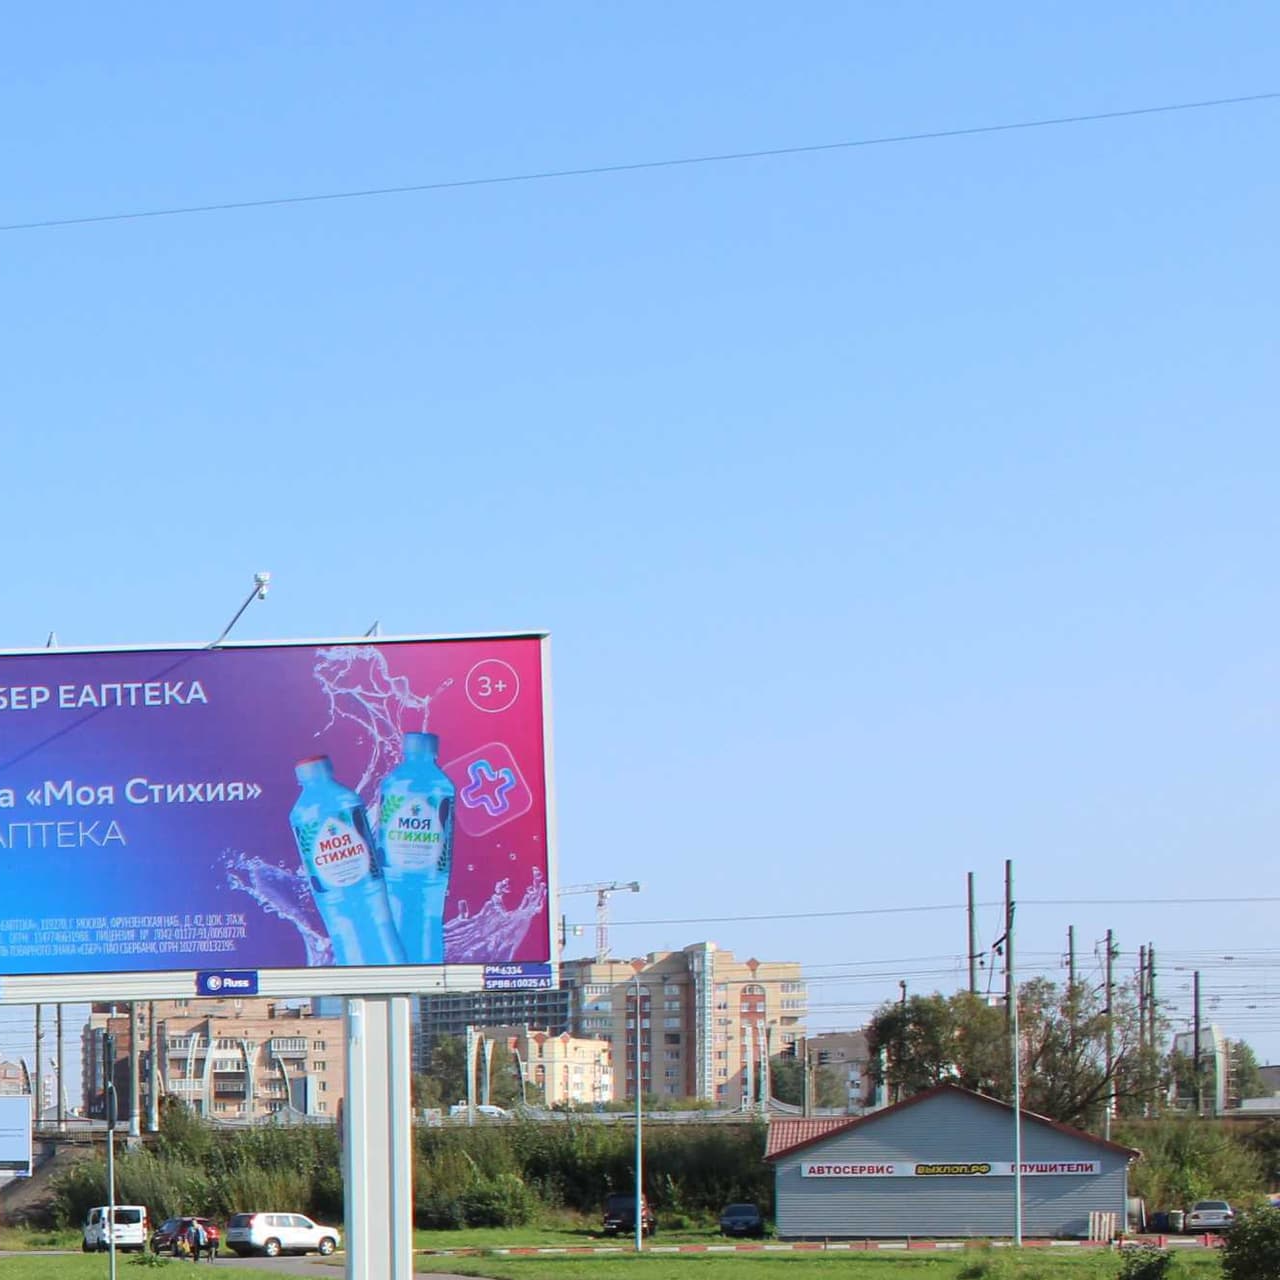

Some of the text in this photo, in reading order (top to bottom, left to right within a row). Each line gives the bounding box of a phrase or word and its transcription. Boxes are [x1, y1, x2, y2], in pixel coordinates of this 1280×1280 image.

[57, 680, 209, 709] ЕАПТЕКА
[478, 676, 507, 696] 3+
[26, 780, 114, 808] «Моя
[124, 778, 263, 805] Стихия»
[398, 817, 432, 831] МОЯ
[319, 833, 353, 853] МОЯ
[388, 830, 441, 844] СТИХИЯ
[314, 843, 366, 867] СТИХИЯ
[808, 1164, 895, 1176] АВТОСЕРВИС
[917, 1164, 991, 1176] ВЫХЛОП.РФ
